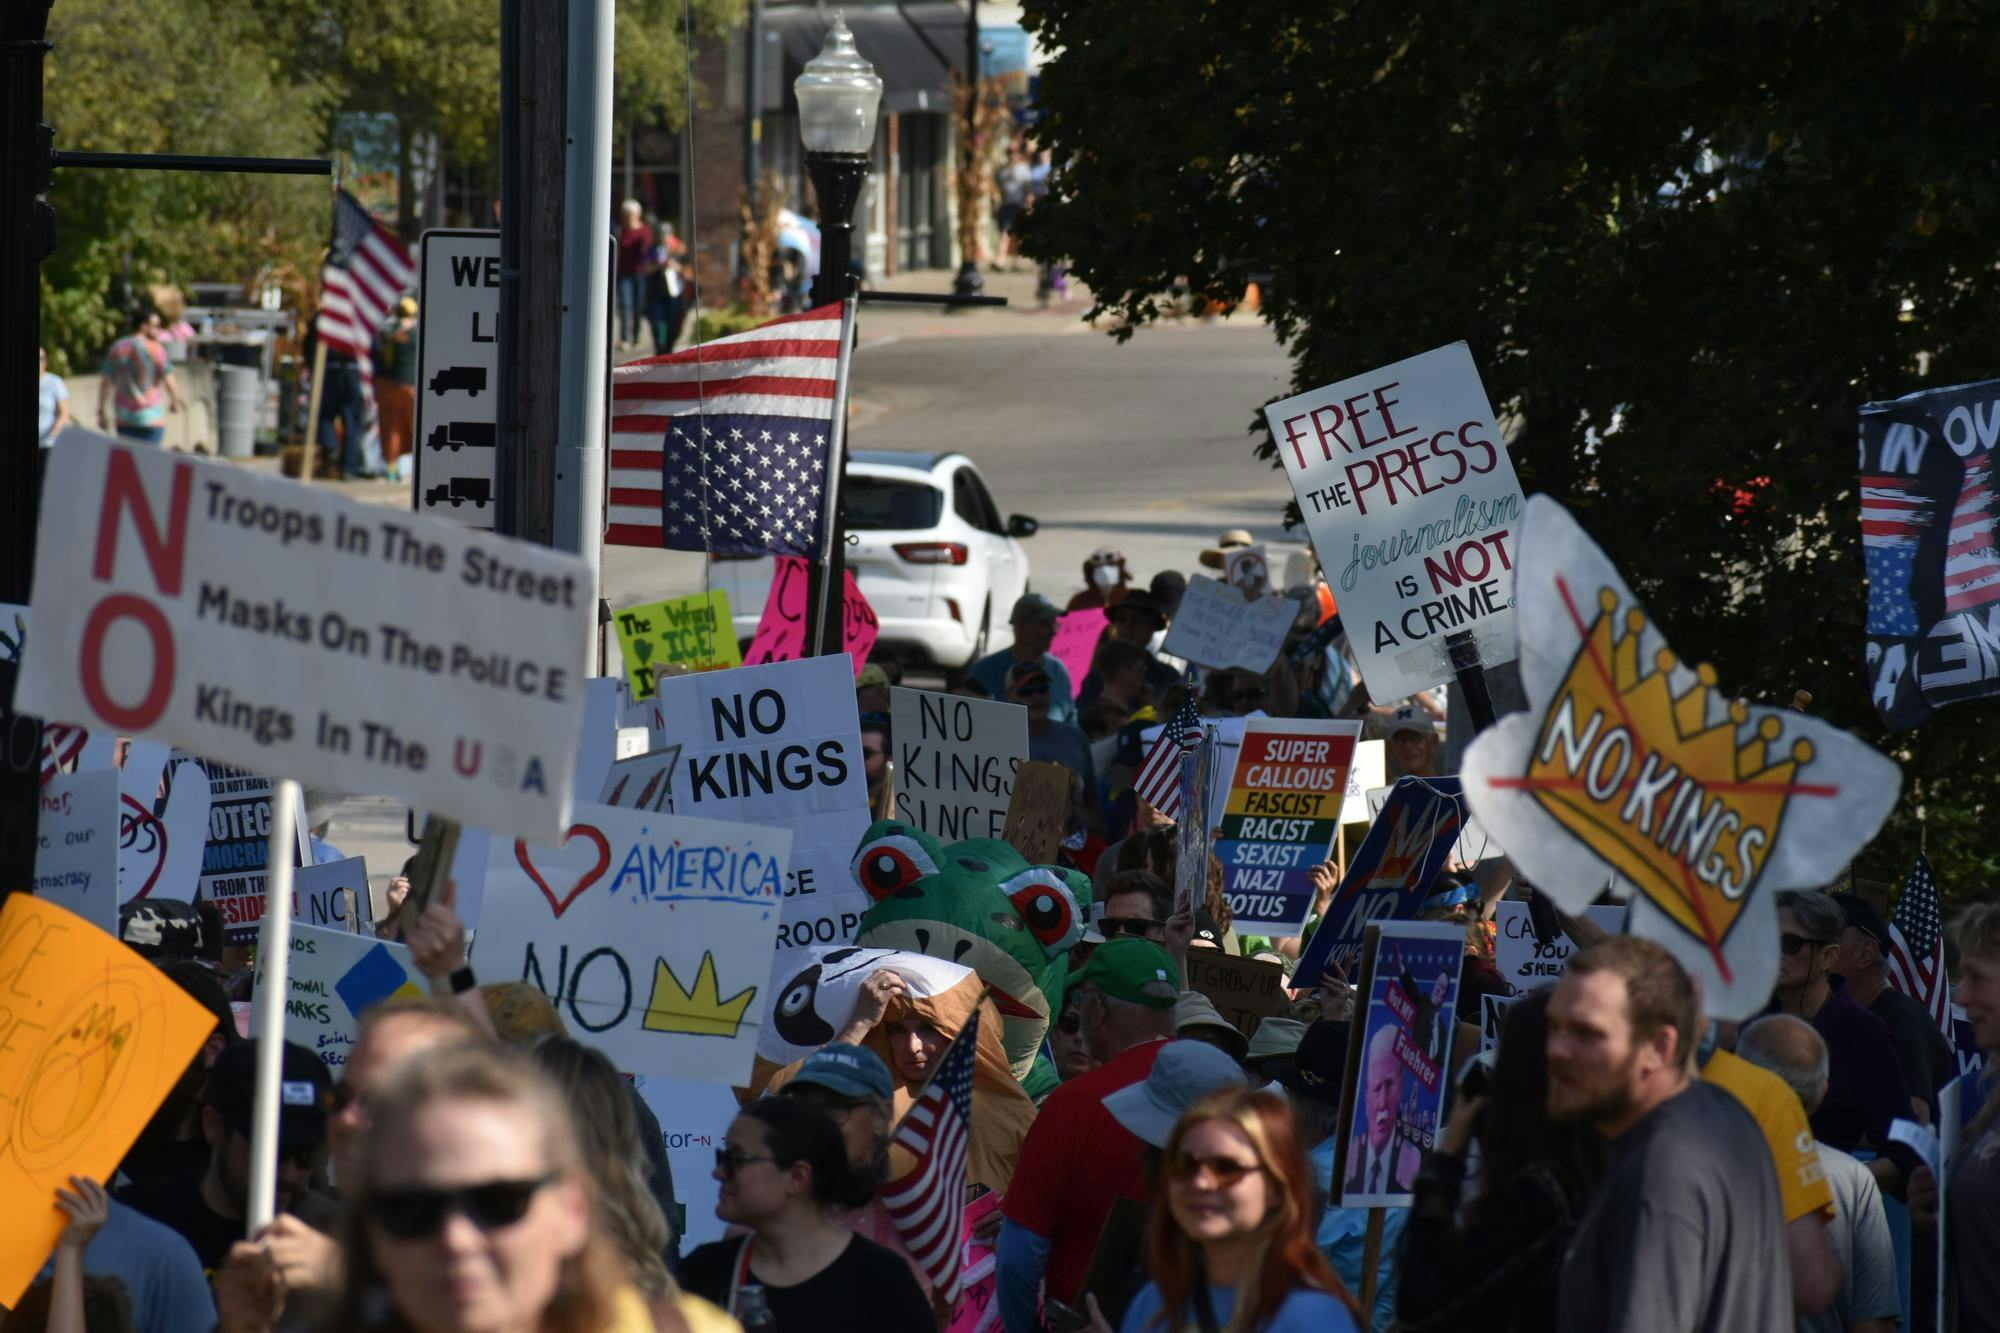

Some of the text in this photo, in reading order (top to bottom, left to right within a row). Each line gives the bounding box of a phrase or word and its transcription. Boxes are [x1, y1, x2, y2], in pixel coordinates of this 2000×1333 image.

[451, 256, 500, 288] WE
[472, 311, 499, 343] L
[1283, 382, 1418, 469] FREE
[1306, 421, 1497, 515] THE PRESS
[206, 480, 577, 609] Troops In The Street
[1341, 493, 1520, 592] journalism
[1394, 530, 1512, 599] IS NOT
[199, 582, 313, 643] Masks
[320, 612, 370, 656] On
[380, 623, 445, 675] The
[619, 613, 651, 636] The
[662, 624, 716, 662] ICE
[1374, 620, 1400, 654] A
[195, 683, 295, 746] Kings
[317, 709, 353, 756] In
[361, 720, 428, 772] The
[711, 688, 786, 742] NO
[920, 695, 973, 741] NO
[689, 741, 849, 802] KINGS
[903, 743, 1019, 797] KINGS
[1264, 739, 1329, 763] SUPER
[226, 779, 244, 793] NOT
[1246, 765, 1335, 790] CALLOUS
[1541, 696, 1765, 898] NO KINGS
[896, 792, 1006, 840] SINCE
[1244, 792, 1325, 815] FASCIST
[1239, 817, 1314, 841] RACIST
[610, 844, 782, 898] AMERICA
[1232, 843, 1305, 866] SEXIST
[33, 871, 92, 892] emocracy
[212, 876, 246, 897] FROM
[1233, 868, 1286, 891] NAZI
[776, 909, 868, 950] ROOP
[1338, 891, 1399, 941] NO
[1533, 942, 1569, 959] YOU
[523, 942, 632, 1033] NO
[285, 1000, 331, 1024] ARKS
[1396, 1036, 1437, 1086] Fuehrer
